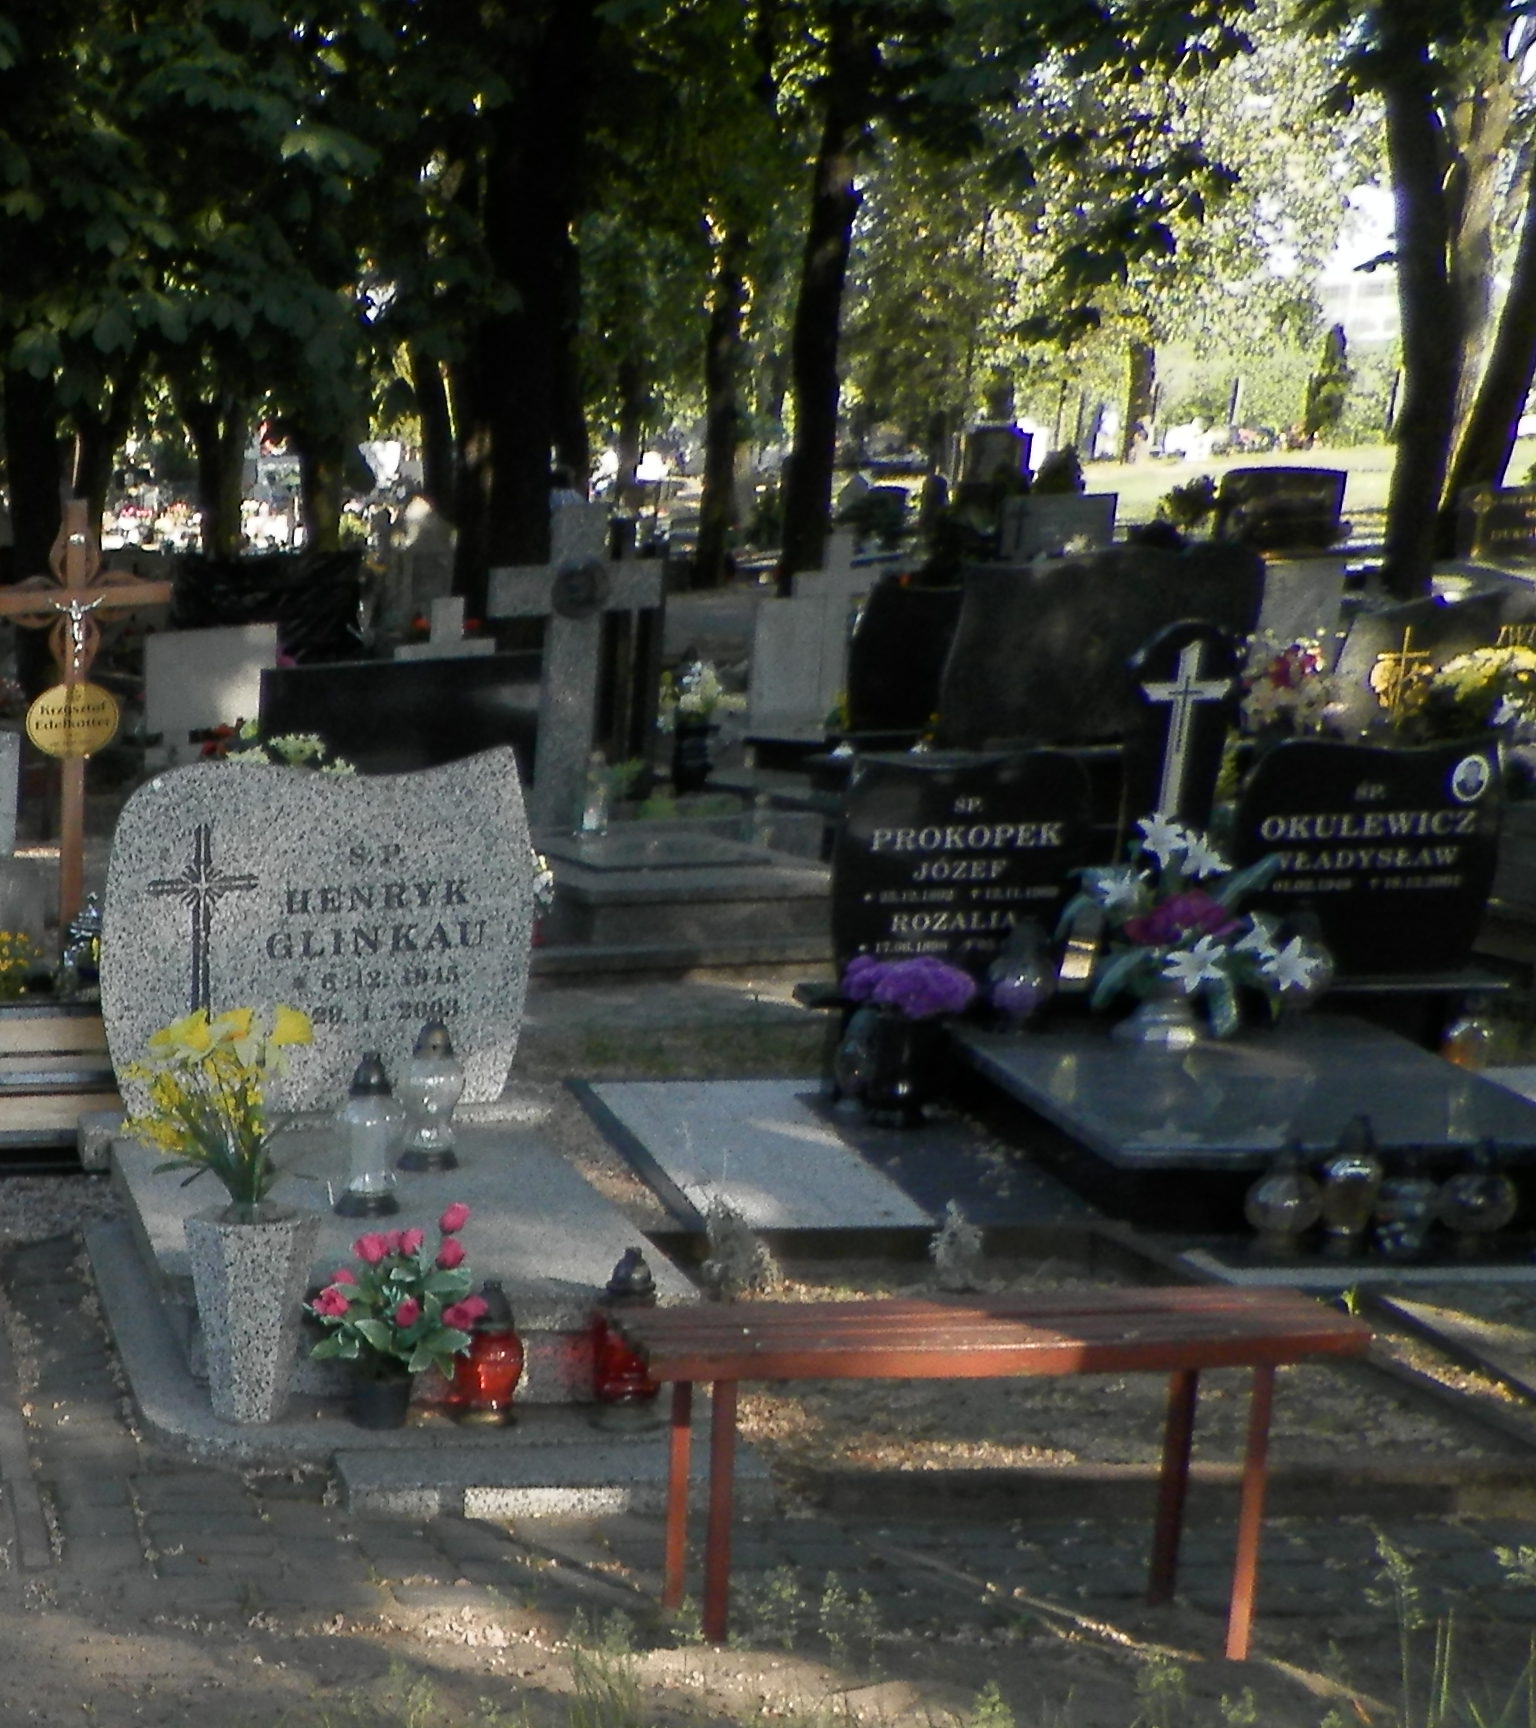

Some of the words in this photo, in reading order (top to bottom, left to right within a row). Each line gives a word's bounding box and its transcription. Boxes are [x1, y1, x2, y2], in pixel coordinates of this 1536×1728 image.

[871, 822, 1063, 851] PROKOPEK
[1260, 809, 1477, 841] OKULEWICZ
[913, 857, 1007, 880] JÓZEF
[284, 878, 469, 914] HENRYK
[891, 911, 1017, 932] ROZALIA
[266, 920, 488, 960] GLINKAU
